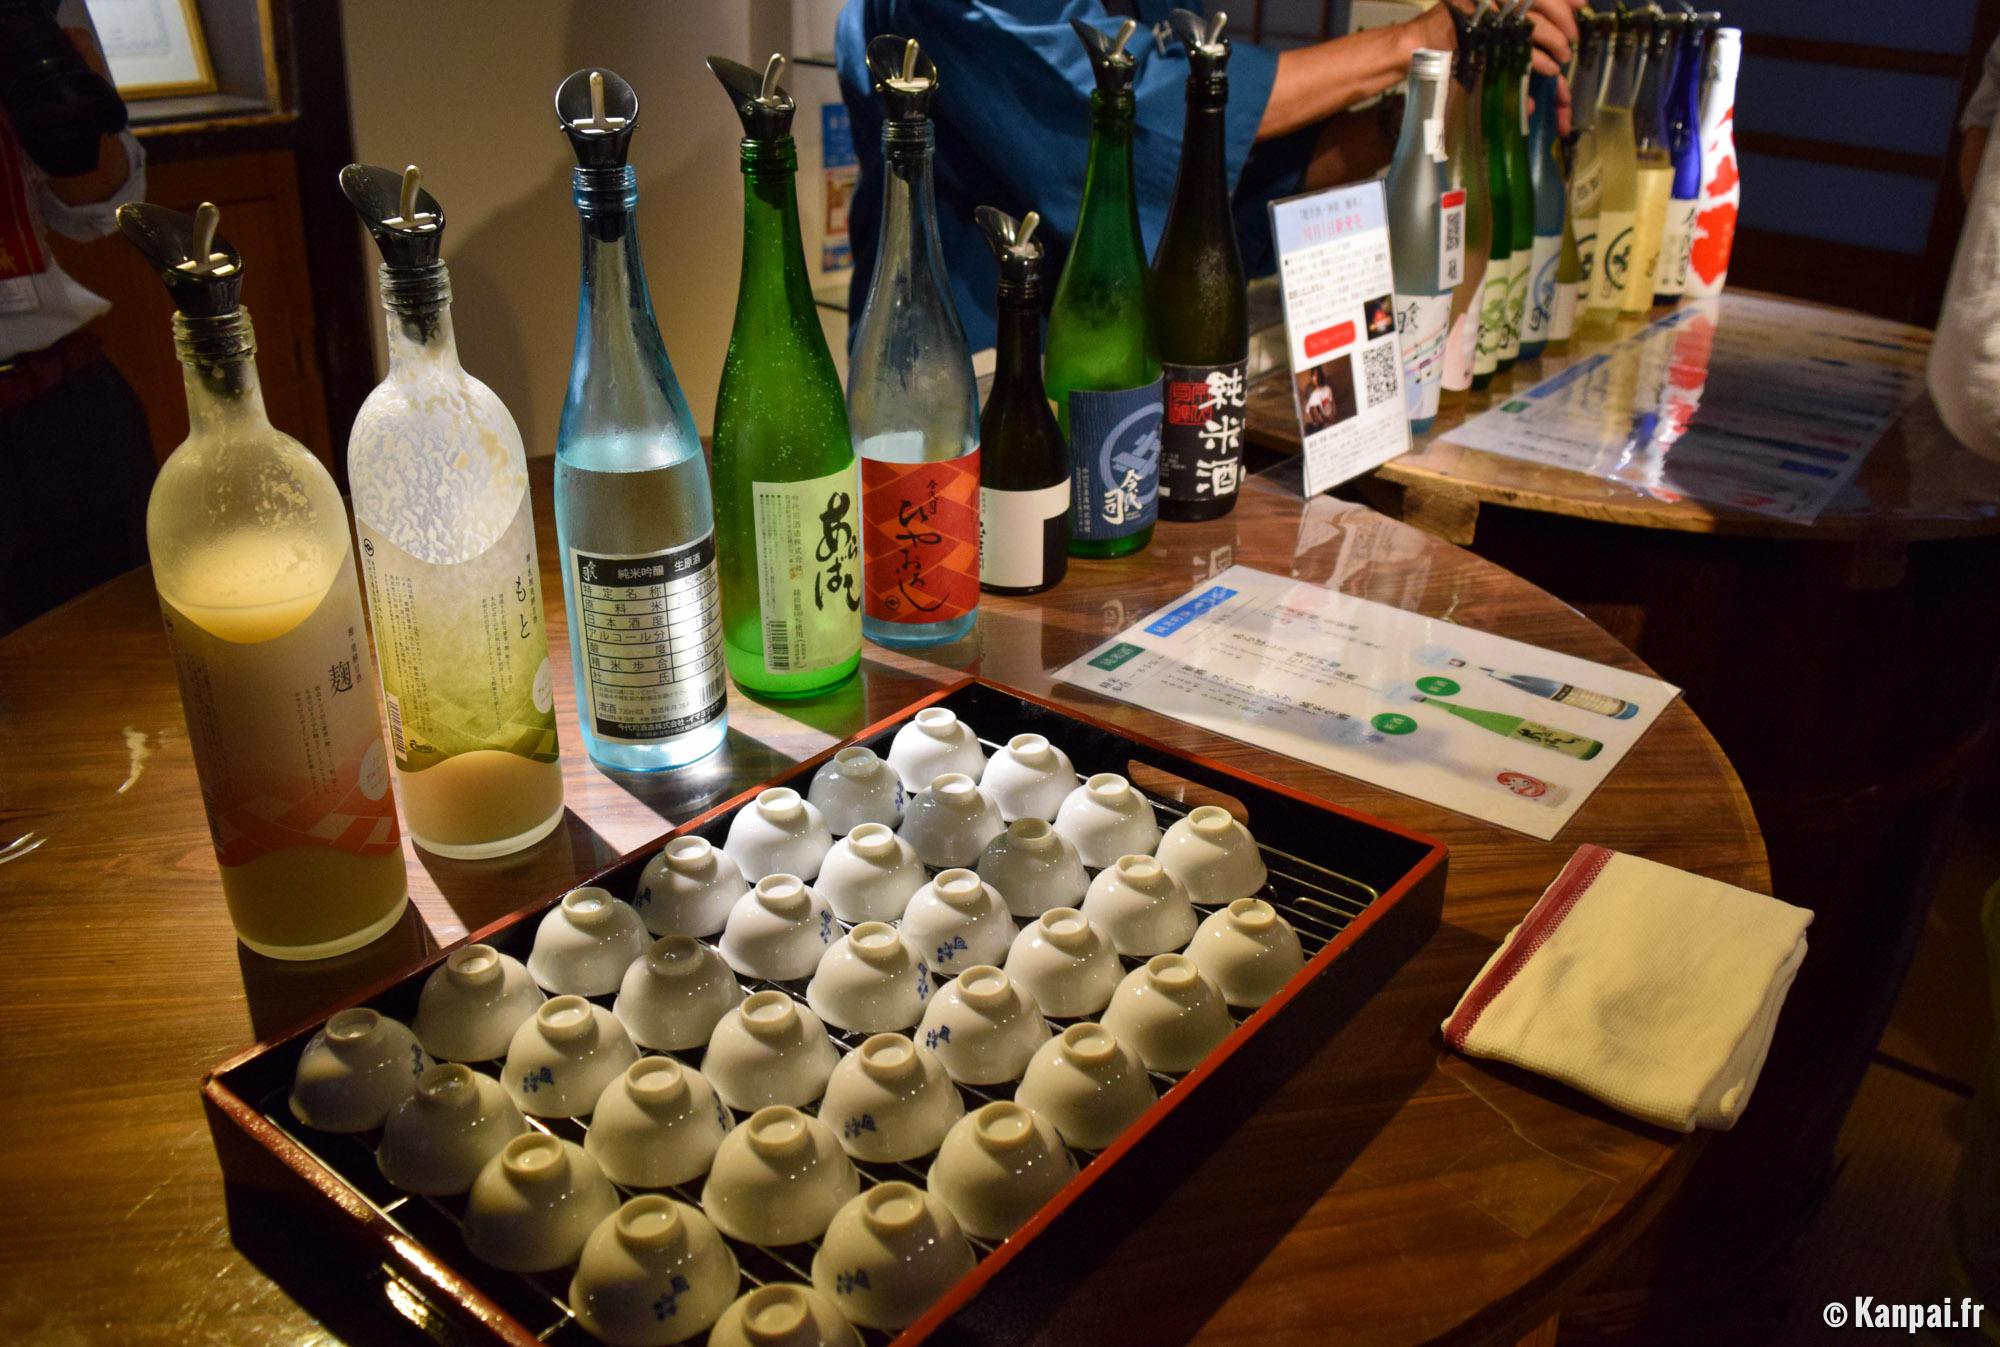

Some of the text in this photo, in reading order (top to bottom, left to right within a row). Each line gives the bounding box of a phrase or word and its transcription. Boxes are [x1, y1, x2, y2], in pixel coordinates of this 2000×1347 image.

[1196, 368, 1245, 497] 純米酒
[617, 552, 701, 581] 純米吟醸 生原酒
[583, 585, 663, 600] 特定名称
[515, 576, 530, 639] もと
[584, 599, 663, 614] 原料米
[586, 613, 664, 629] 日本酒度
[587, 628, 665, 643] アルコール分
[590, 657, 668, 672] 精米歩合
[328, 660, 354, 698] 麹
